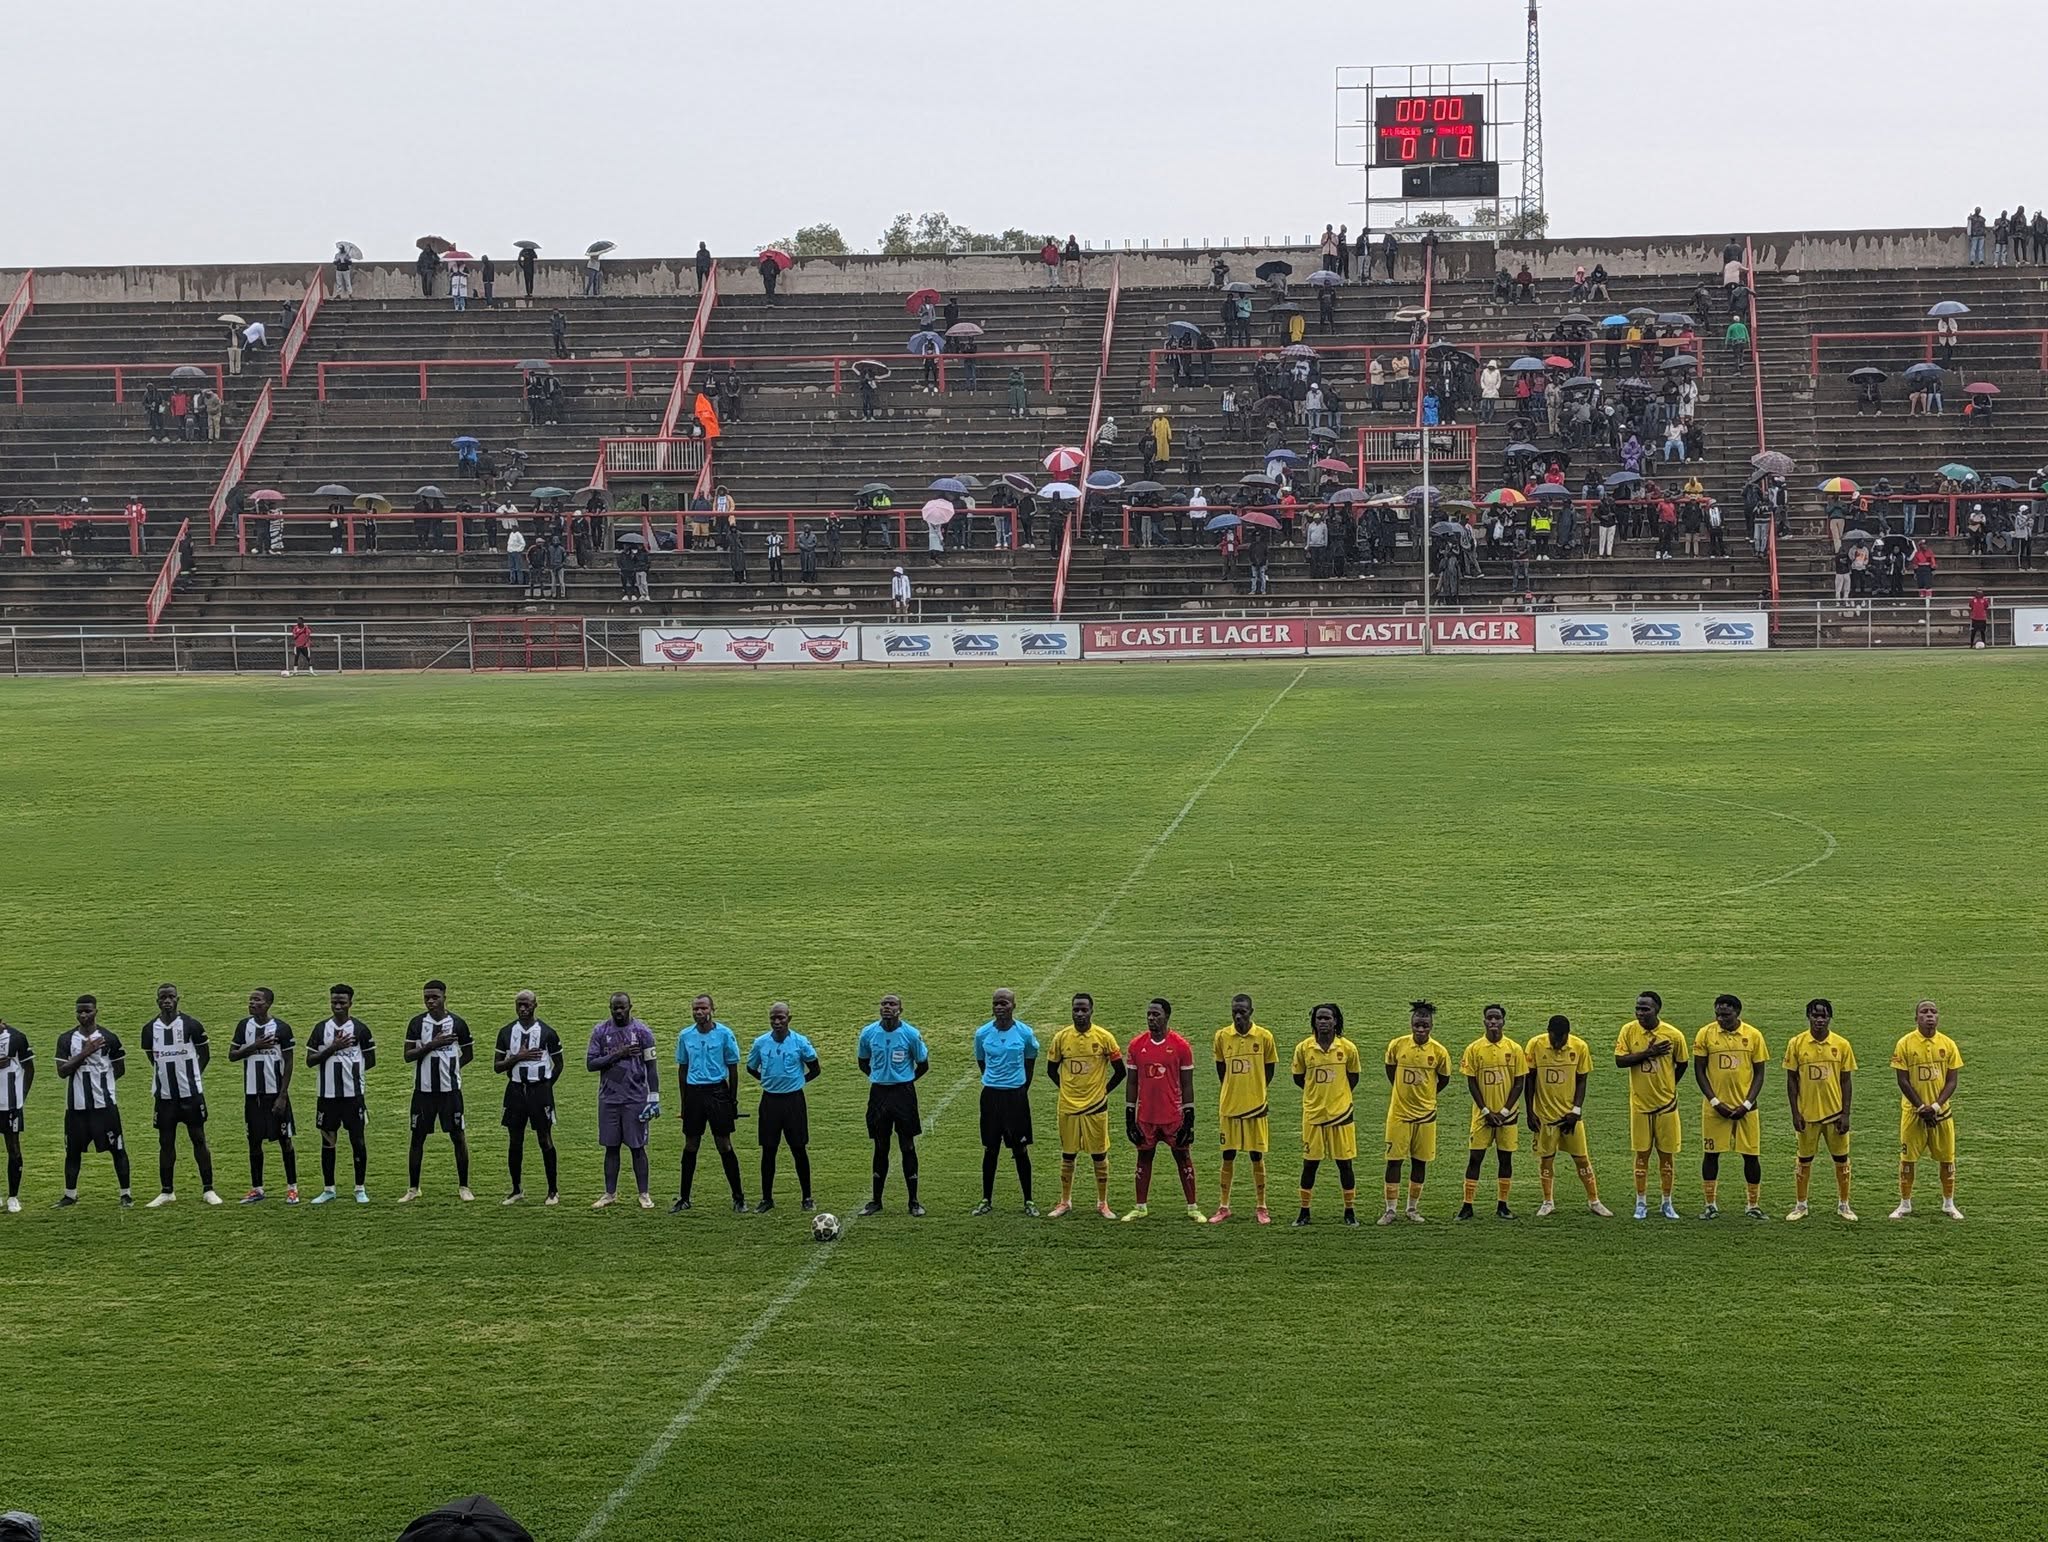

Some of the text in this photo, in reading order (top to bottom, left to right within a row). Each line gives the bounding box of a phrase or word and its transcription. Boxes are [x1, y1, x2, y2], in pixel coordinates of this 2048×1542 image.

[1397, 98, 1462, 121] 00:00
[1402, 137, 1415, 159] 0
[1459, 136, 1472, 158] 0
[1121, 624, 1291, 645] CASTLE LAGER
[1438, 621, 1520, 641] LAGER
